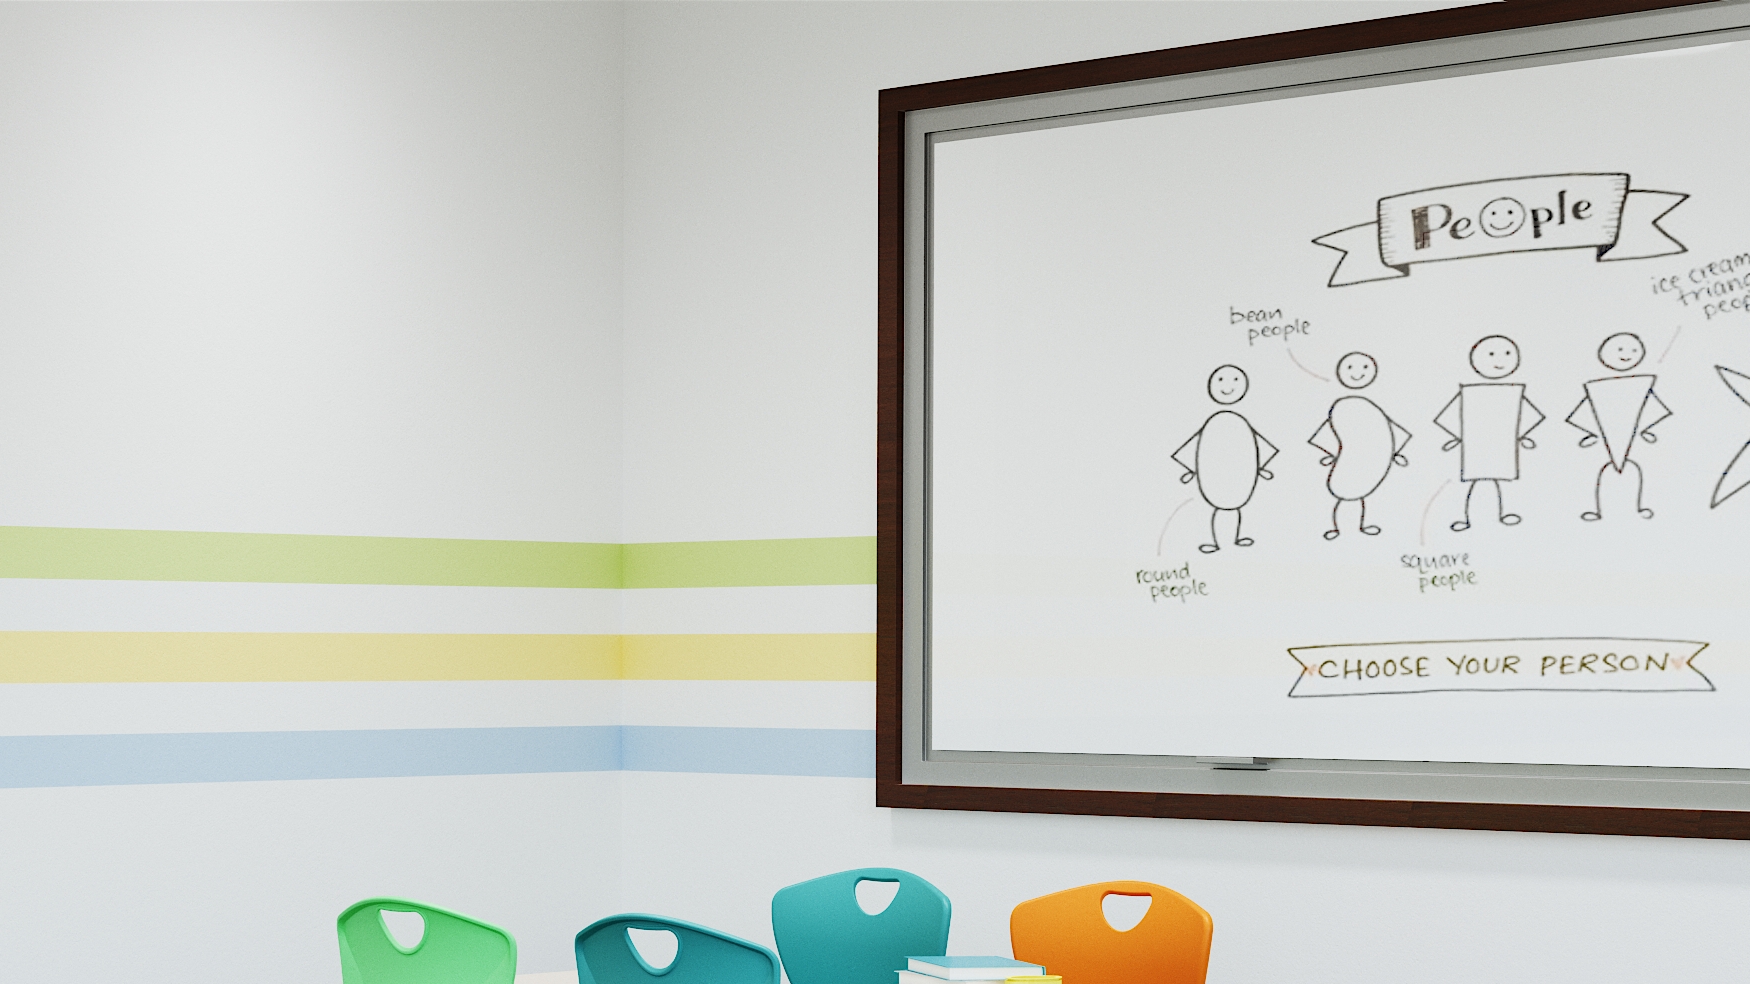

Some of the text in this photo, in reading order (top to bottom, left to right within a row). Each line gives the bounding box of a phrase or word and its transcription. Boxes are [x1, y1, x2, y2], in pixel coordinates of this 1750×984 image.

[1651, 275, 1680, 294] ice
[1230, 306, 1282, 324] bean
[1249, 319, 1310, 346] people
[1136, 562, 1190, 584] round
[1401, 553, 1469, 574] square
[1151, 579, 1209, 604] people
[1419, 570, 1477, 593] people
[1318, 652, 1670, 680] CHOOSE YOUR PERSON
